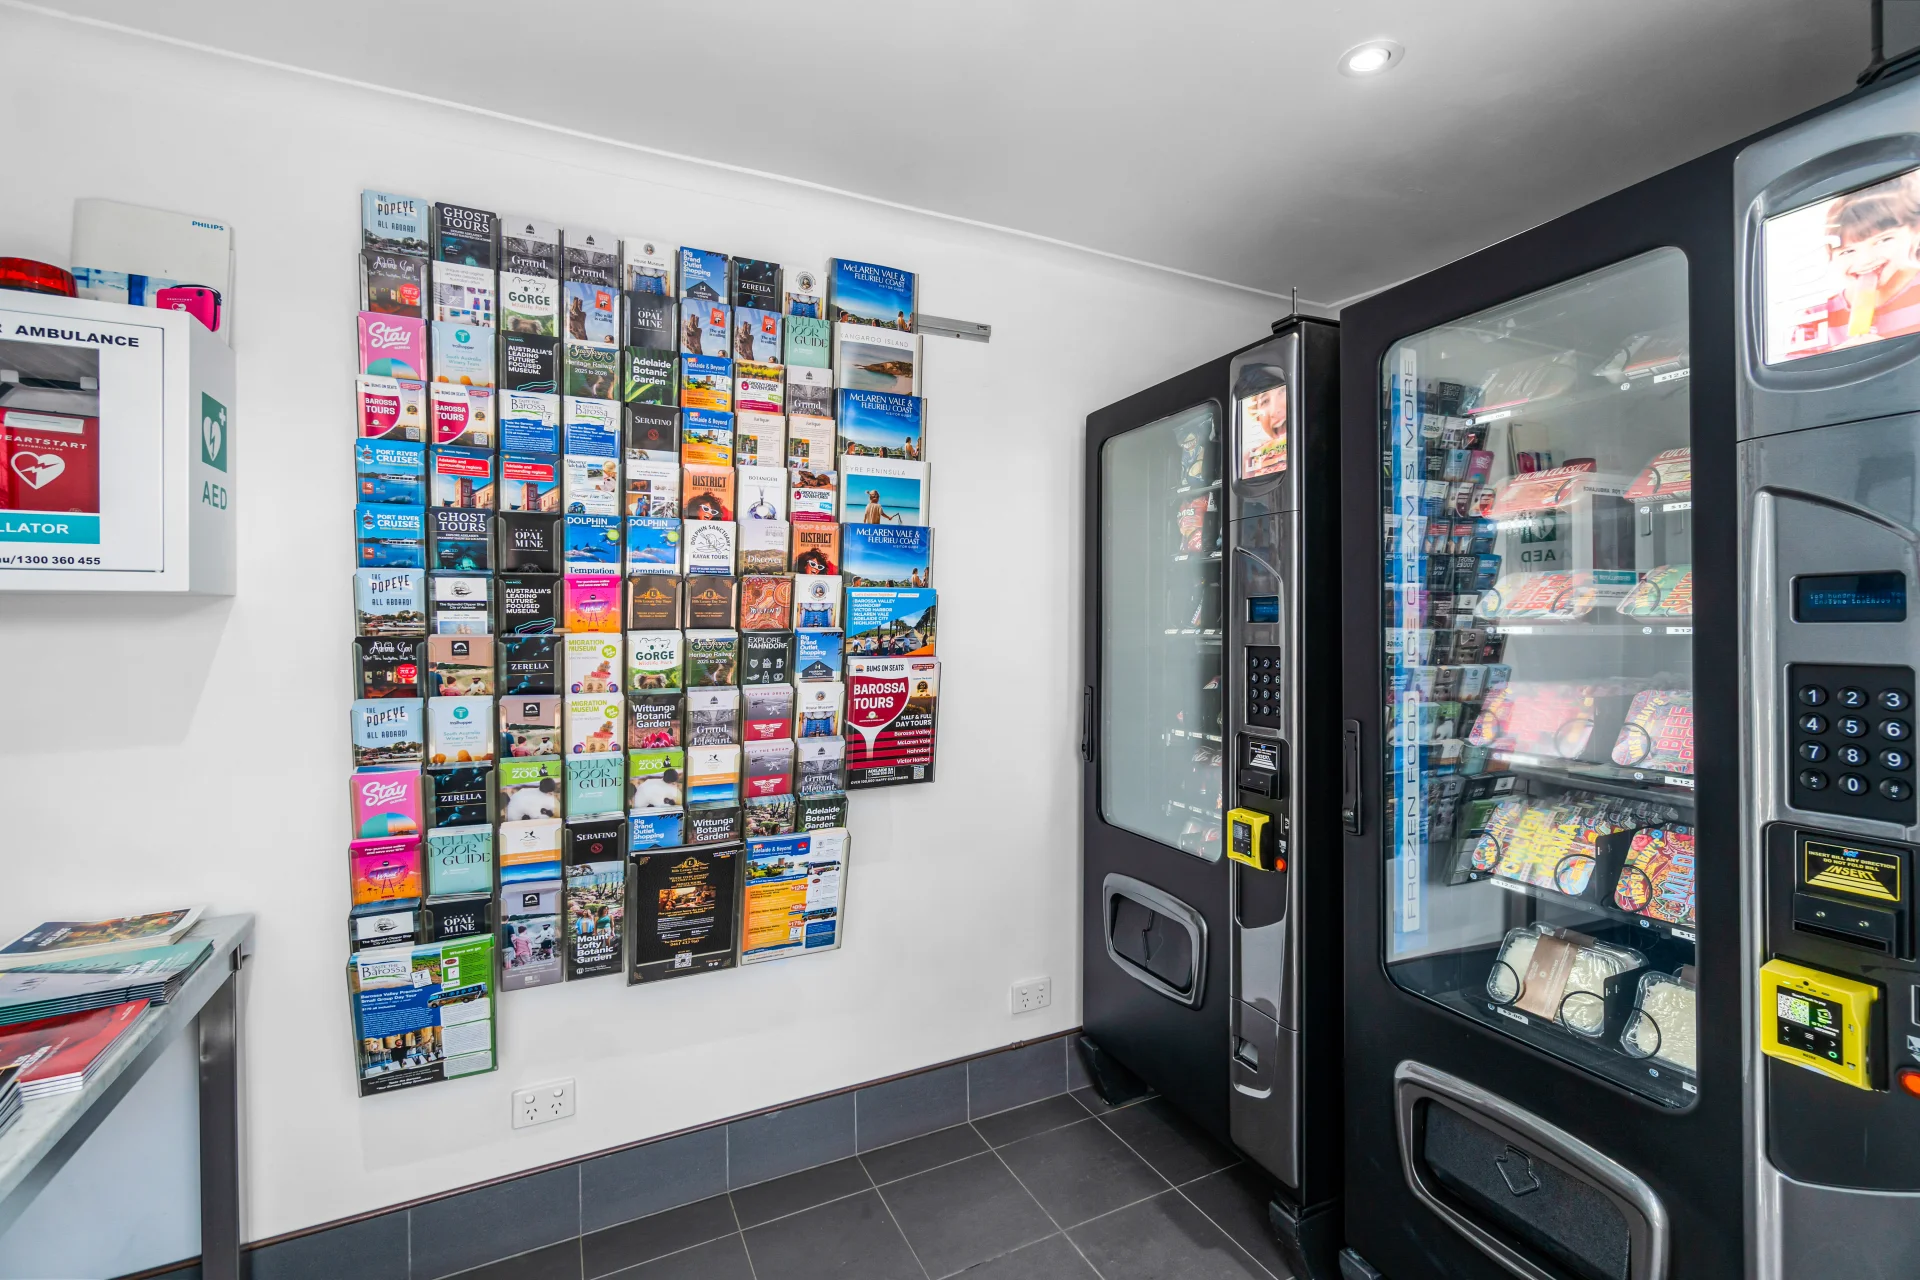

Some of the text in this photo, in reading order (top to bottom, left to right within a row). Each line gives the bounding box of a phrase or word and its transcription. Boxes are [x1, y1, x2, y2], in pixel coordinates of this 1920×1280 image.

[444, 207, 490, 223] GHOST
[192, 220, 224, 231] PHILIPS
[444, 217, 490, 232] TOURS
[511, 255, 549, 270] Grand.
[572, 266, 607, 280] Grand.
[854, 272, 905, 288] FLEURIEU COAST
[741, 282, 771, 293] ZERELLA
[508, 292, 550, 305] GORGE
[638, 311, 662, 320] OPAL
[638, 319, 662, 328] MINE
[15, 325, 139, 347] AMBULANCE
[368, 322, 412, 349] Stay
[508, 345, 553, 355] AUSTRALIA'S
[508, 351, 539, 359] LEADING
[508, 361, 542, 370] FOCUSED
[633, 357, 671, 369] Adelaide
[633, 366, 667, 377] Botanic
[633, 375, 665, 385] Garden
[365, 398, 397, 406] BAROSSA
[366, 405, 395, 415] TOURS
[861, 402, 913, 414] FLEURIEU COAST
[635, 416, 671, 426] SERAFINO
[376, 455, 418, 464] CRUISES
[1515, 463, 1591, 482] CUCINA CLASSICA
[693, 475, 727, 488] DISTRICT
[202, 480, 228, 511] AED
[1405, 359, 1416, 663] ICE CREAM & MORE
[438, 512, 486, 522] GHOST
[567, 517, 608, 525] DOLPHIN
[377, 520, 420, 528] CRUISES
[439, 522, 486, 532] TOURS
[629, 519, 668, 527] DOLPHIN
[515, 532, 543, 540] OPAL
[800, 532, 832, 544] DISTRICT
[857, 528, 894, 537] McLAREN
[896, 530, 913, 538] VALE
[515, 540, 544, 548] MINE
[78, 557, 100, 565] 455
[569, 567, 615, 575] Temptation
[372, 575, 410, 594] POPEYE
[635, 651, 674, 661] GORGE
[854, 683, 906, 695] BAROSSA
[1809, 690, 1816, 703] 1
[1847, 692, 1857, 704] 2
[1887, 693, 1900, 707] 3
[632, 703, 676, 713] Wittunga
[854, 697, 894, 709] TOURS
[366, 706, 405, 727] POPEYE
[636, 720, 671, 728] Garden
[910, 719, 932, 727] TOURS
[1656, 706, 1693, 750] BEEF
[1807, 718, 1817, 731] 4
[1846, 720, 1857, 733] 5
[696, 725, 729, 734] Grand.
[1887, 723, 1900, 736] 6
[1809, 746, 1819, 759] 7
[1848, 749, 1858, 762] 8
[1888, 753, 1901, 767] 9
[639, 762, 663, 770] ZOO
[512, 770, 539, 778] ZOO
[568, 769, 610, 780] DOOR
[804, 774, 835, 783] Grand.
[579, 778, 622, 789] GUIDE
[1848, 778, 1858, 791] 0
[362, 782, 407, 806] Stay
[441, 794, 482, 802] ZERELLA
[805, 806, 840, 815] Adelaide
[1407, 697, 1417, 919] FROZEN FOOD
[693, 817, 734, 828] Wittunga
[697, 825, 731, 834] Botanic
[576, 831, 617, 842] SERAFINO
[697, 832, 729, 841] Garden
[1501, 808, 1546, 874] CHICKEN
[430, 844, 477, 858] DOOR
[442, 853, 490, 866] GUIDE
[1861, 860, 1896, 869] DIRECTION
[1825, 865, 1876, 880] INSERT
[444, 916, 475, 926] OPAL
[444, 923, 476, 934] MINE
[577, 934, 609, 943] Mount
[577, 941, 602, 951] Lofty
[576, 947, 614, 957] Botanic
[576, 953, 612, 964] Garden
[362, 965, 407, 978] Barossa
